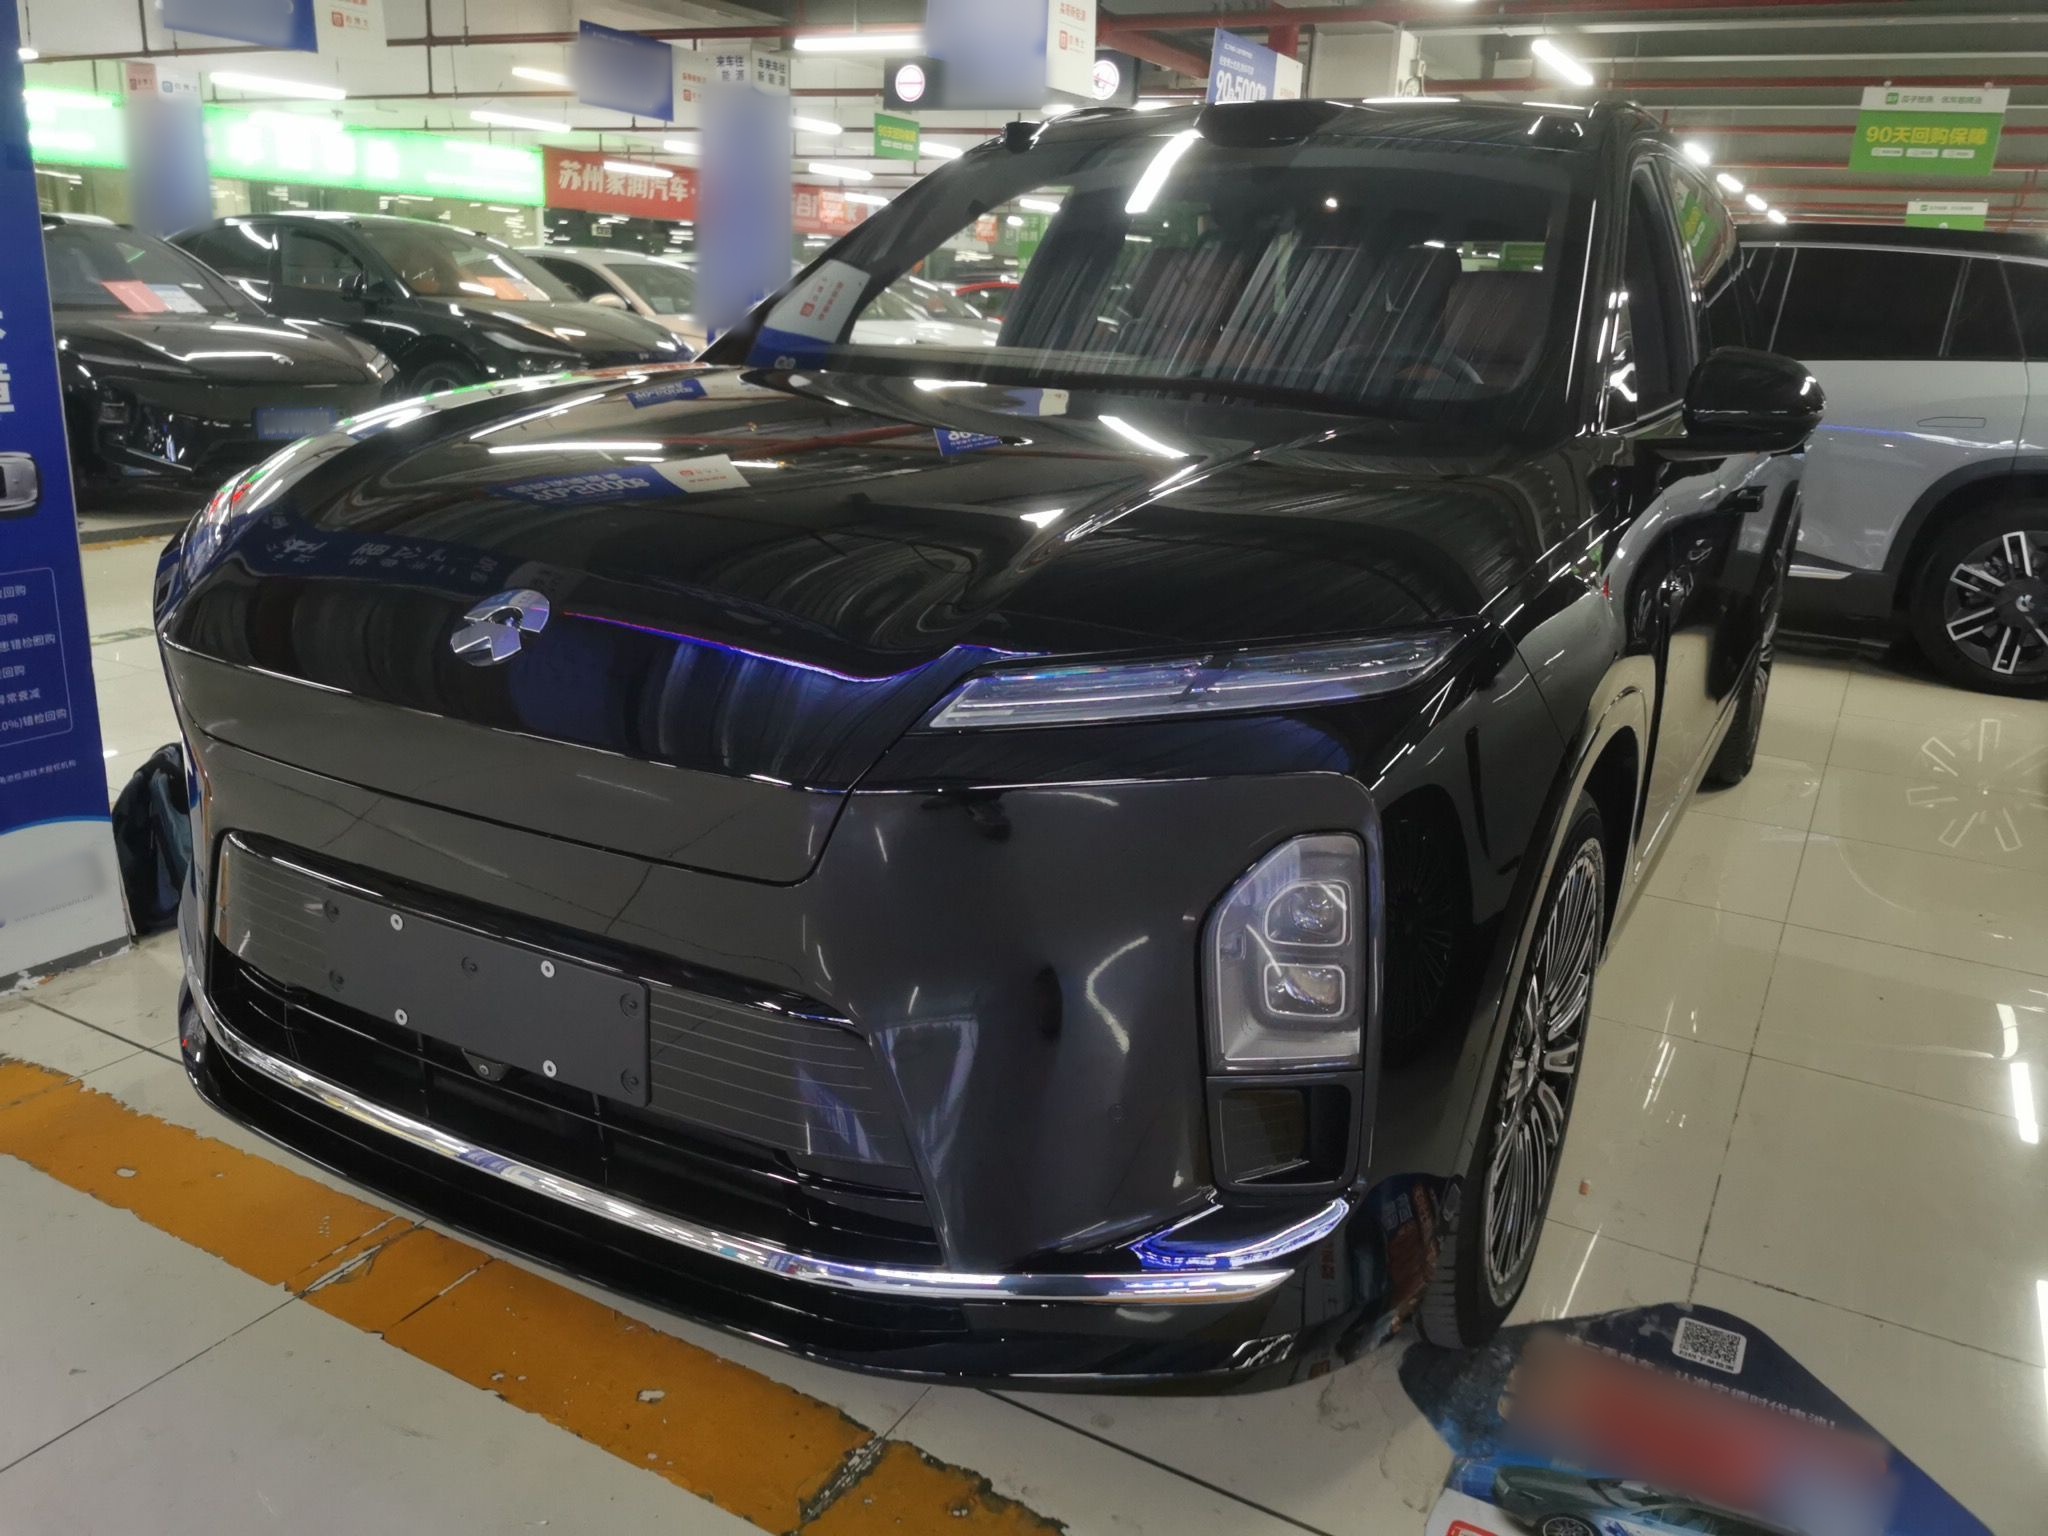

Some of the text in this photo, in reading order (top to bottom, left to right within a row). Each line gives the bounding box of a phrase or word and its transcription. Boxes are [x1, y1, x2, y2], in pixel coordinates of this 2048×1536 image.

[1866, 126, 1987, 145] 90天回购保障
[559, 160, 689, 202] 苏州家润汽车
[0, 585, 26, 598] 回购
[0, 665, 25, 679] 回购
